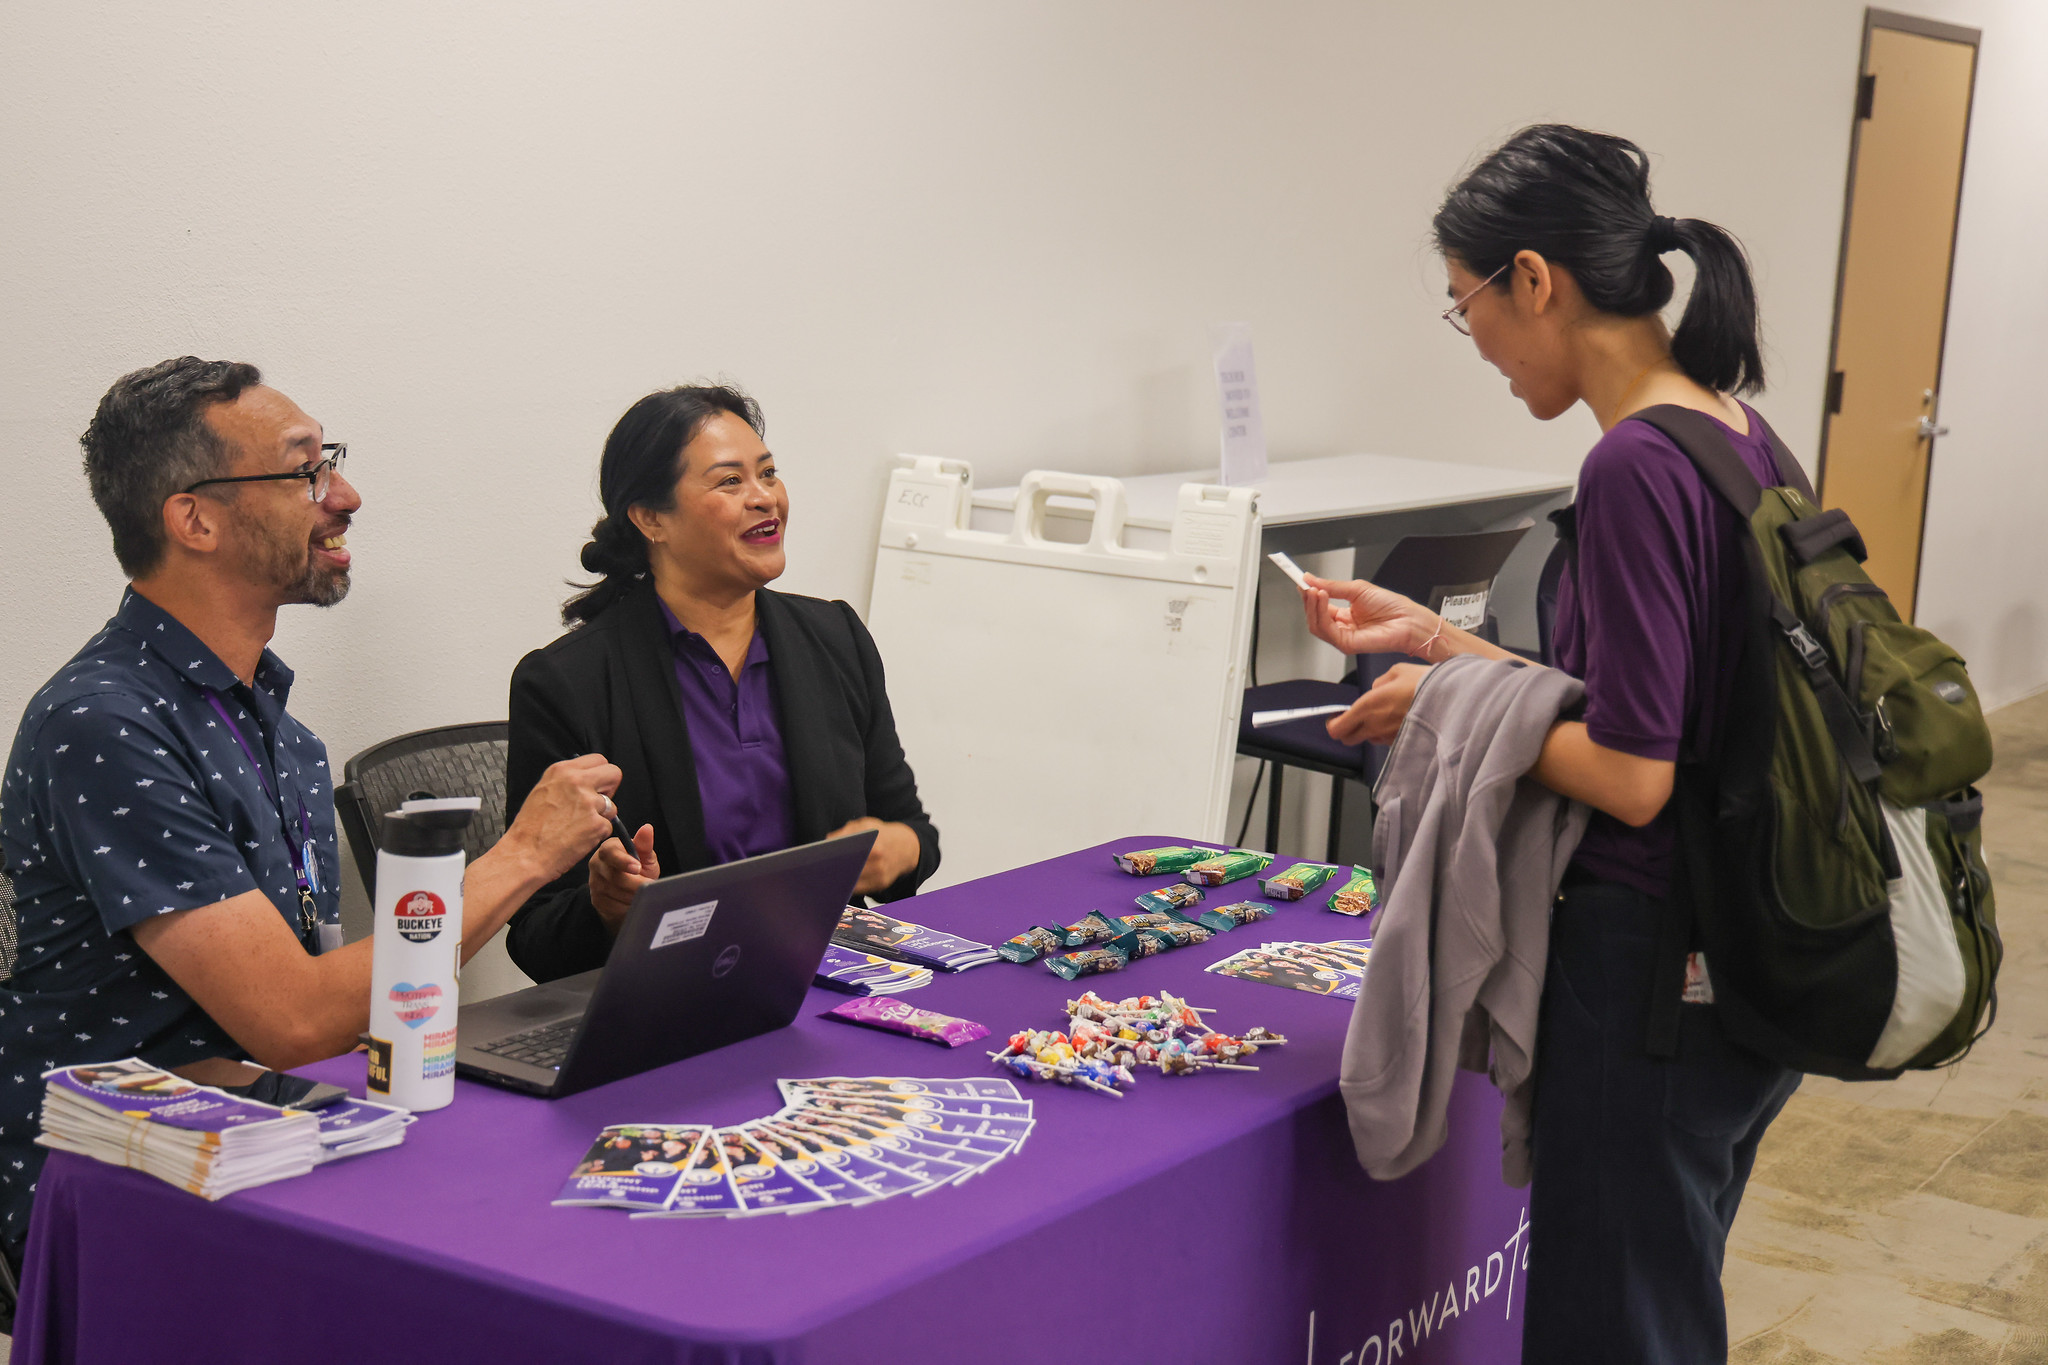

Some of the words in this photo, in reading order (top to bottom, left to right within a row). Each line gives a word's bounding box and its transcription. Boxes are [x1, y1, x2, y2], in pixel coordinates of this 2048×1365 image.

[397, 917, 443, 930] BUCKEYE
[402, 1000, 430, 1010] TRANS
[1339, 1251, 1504, 1365] ORWARD
